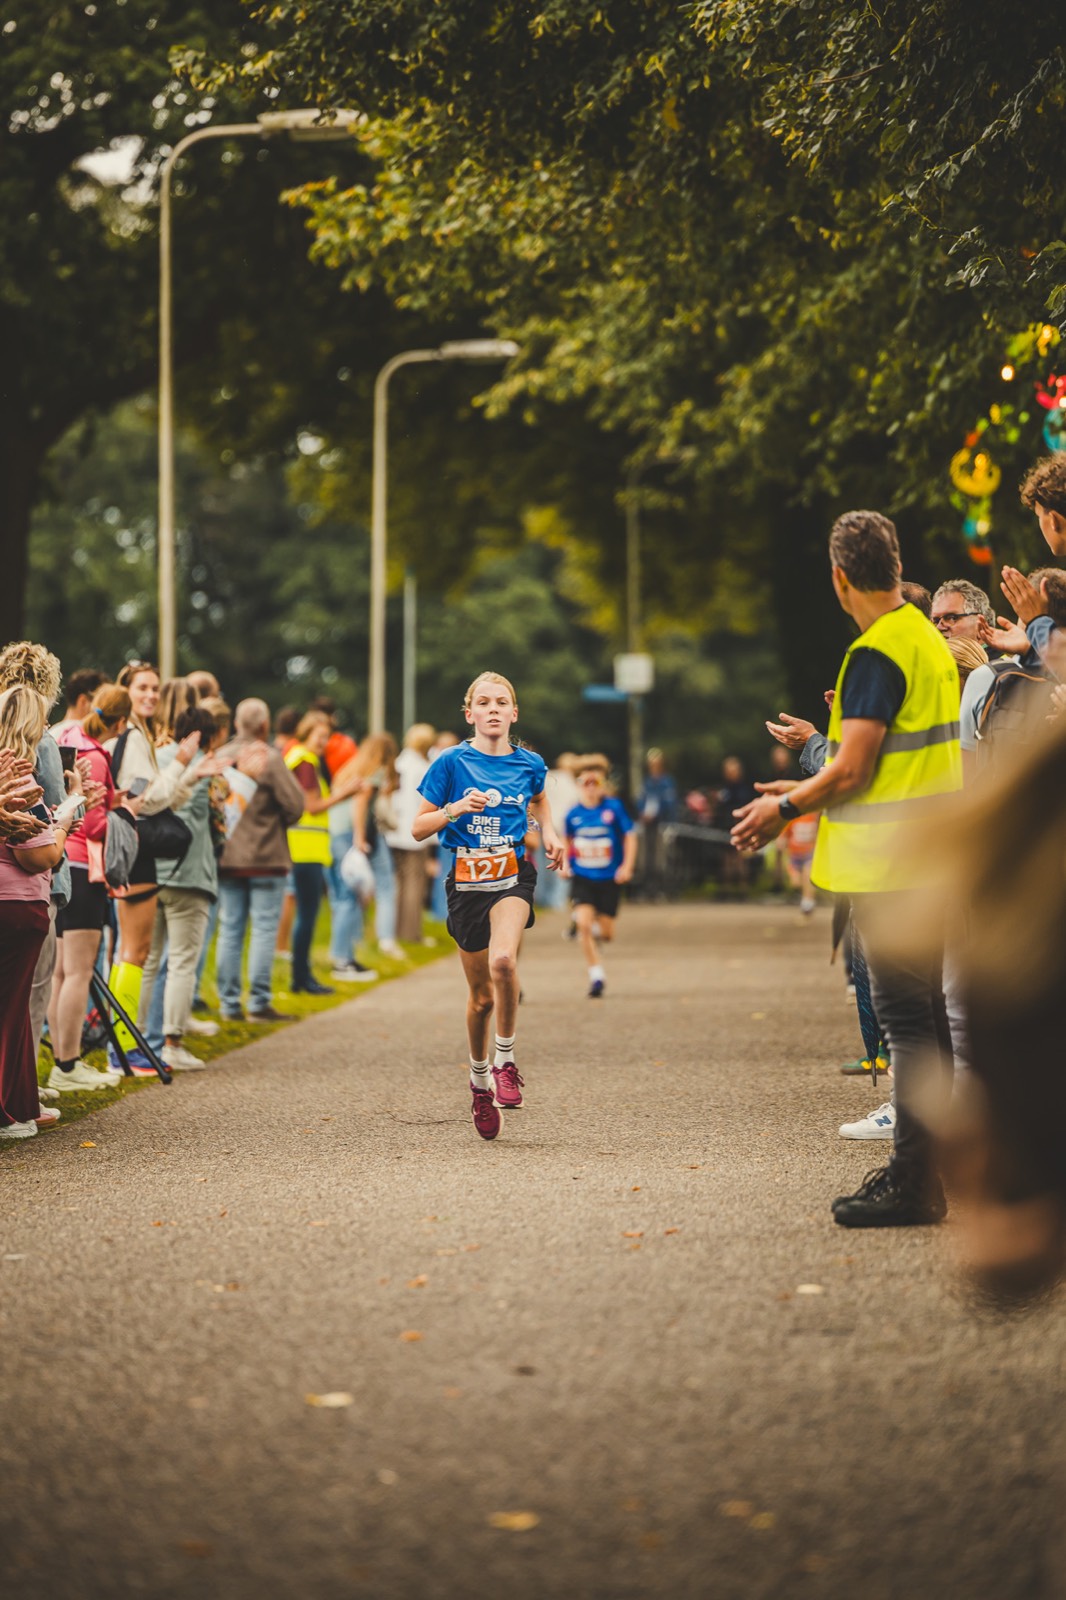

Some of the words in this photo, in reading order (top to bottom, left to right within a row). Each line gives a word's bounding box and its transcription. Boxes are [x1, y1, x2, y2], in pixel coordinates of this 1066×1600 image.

[472, 815, 501, 827] BIKE
[466, 823, 500, 836] BASE
[480, 834, 514, 846] MENT
[466, 856, 508, 880] 127
